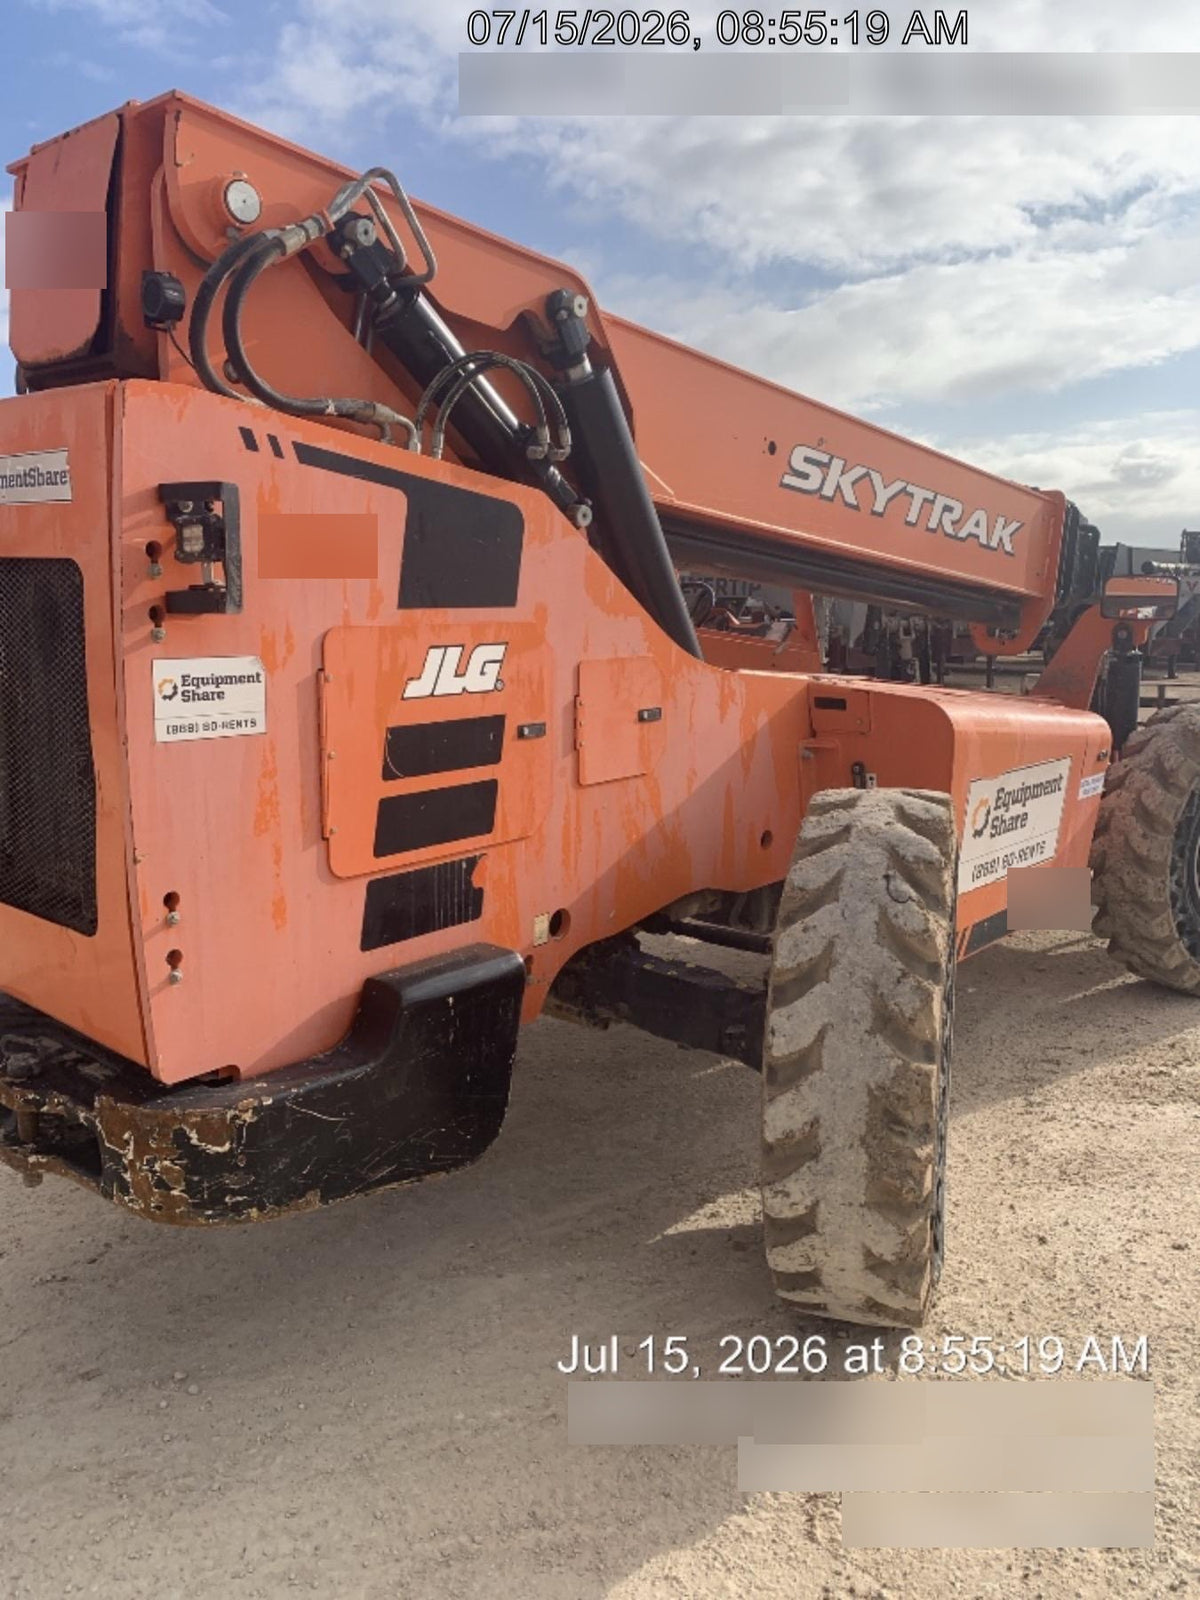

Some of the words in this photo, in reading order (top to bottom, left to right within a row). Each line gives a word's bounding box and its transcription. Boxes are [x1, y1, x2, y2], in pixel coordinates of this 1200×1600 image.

[779, 444, 1024, 556] SKYTRAK
[180, 671, 262, 689] Equipment
[401, 642, 508, 700] JLG
[180, 689, 225, 703] Share
[993, 773, 1063, 812] Equipment
[990, 812, 1028, 839] Share
